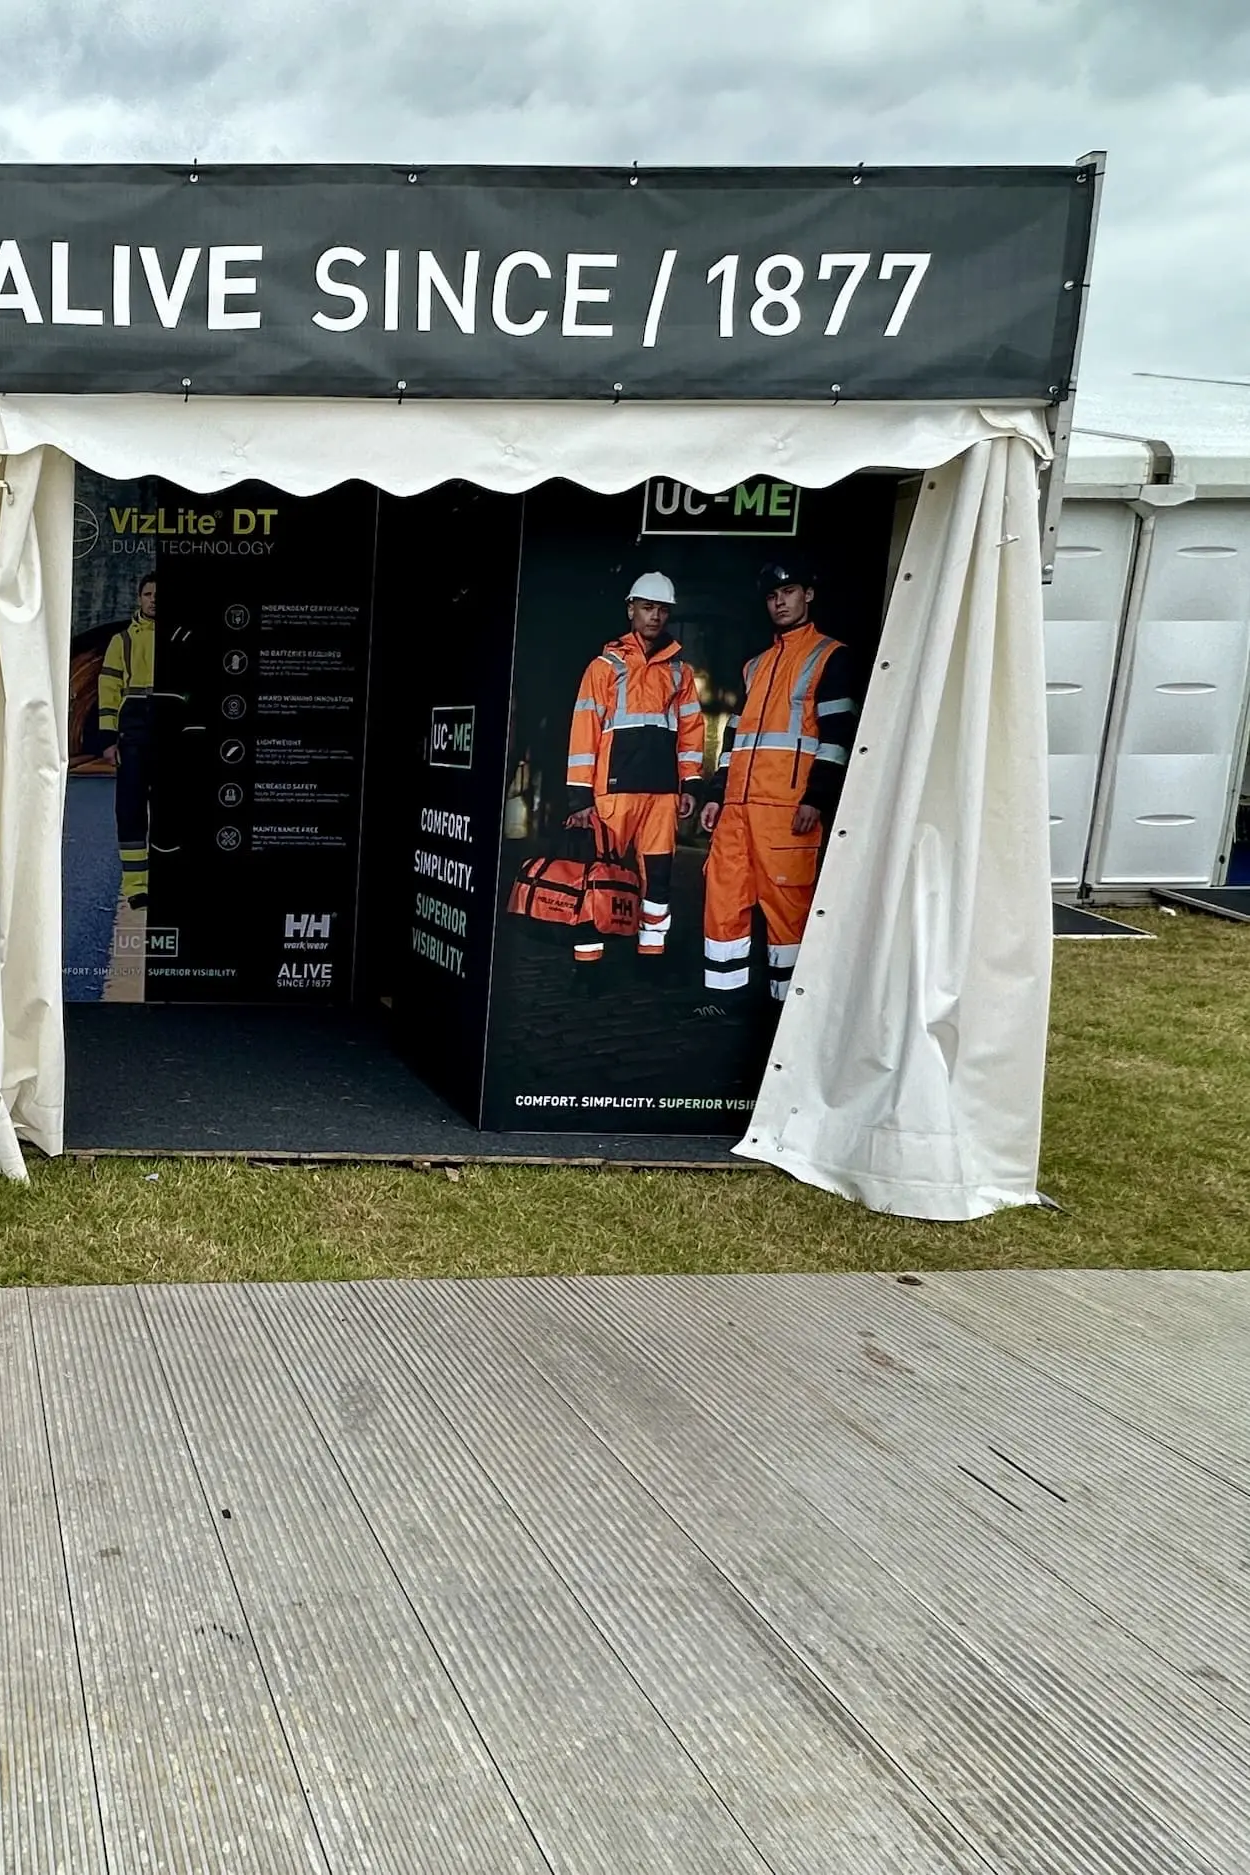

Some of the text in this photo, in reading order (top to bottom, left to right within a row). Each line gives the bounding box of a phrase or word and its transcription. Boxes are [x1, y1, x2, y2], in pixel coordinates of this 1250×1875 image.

[311, 247, 618, 339] SINCE
[705, 252, 932, 339] 1877
[655, 482, 792, 516] UC-ME
[233, 508, 279, 535] DT
[112, 539, 275, 555] DUAL TECHNOLOGY
[433, 722, 472, 752] UC-ME
[421, 807, 473, 843] COMFORT.
[414, 849, 475, 893] SIMPLICITY.
[415, 892, 467, 938] SUPERIOR
[119, 935, 176, 949] UC-ME
[411, 926, 466, 979] VISIBILITY.
[148, 968, 190, 977] SUPERIOR
[192, 968, 238, 977] VISIBILITY.
[276, 979, 304, 988] SINCE
[277, 962, 333, 979] ALIVE
[515, 1095, 579, 1108] COMFORT.
[581, 1096, 655, 1109] SIMPLICITY.
[658, 1098, 723, 1110] SUPERIOR
